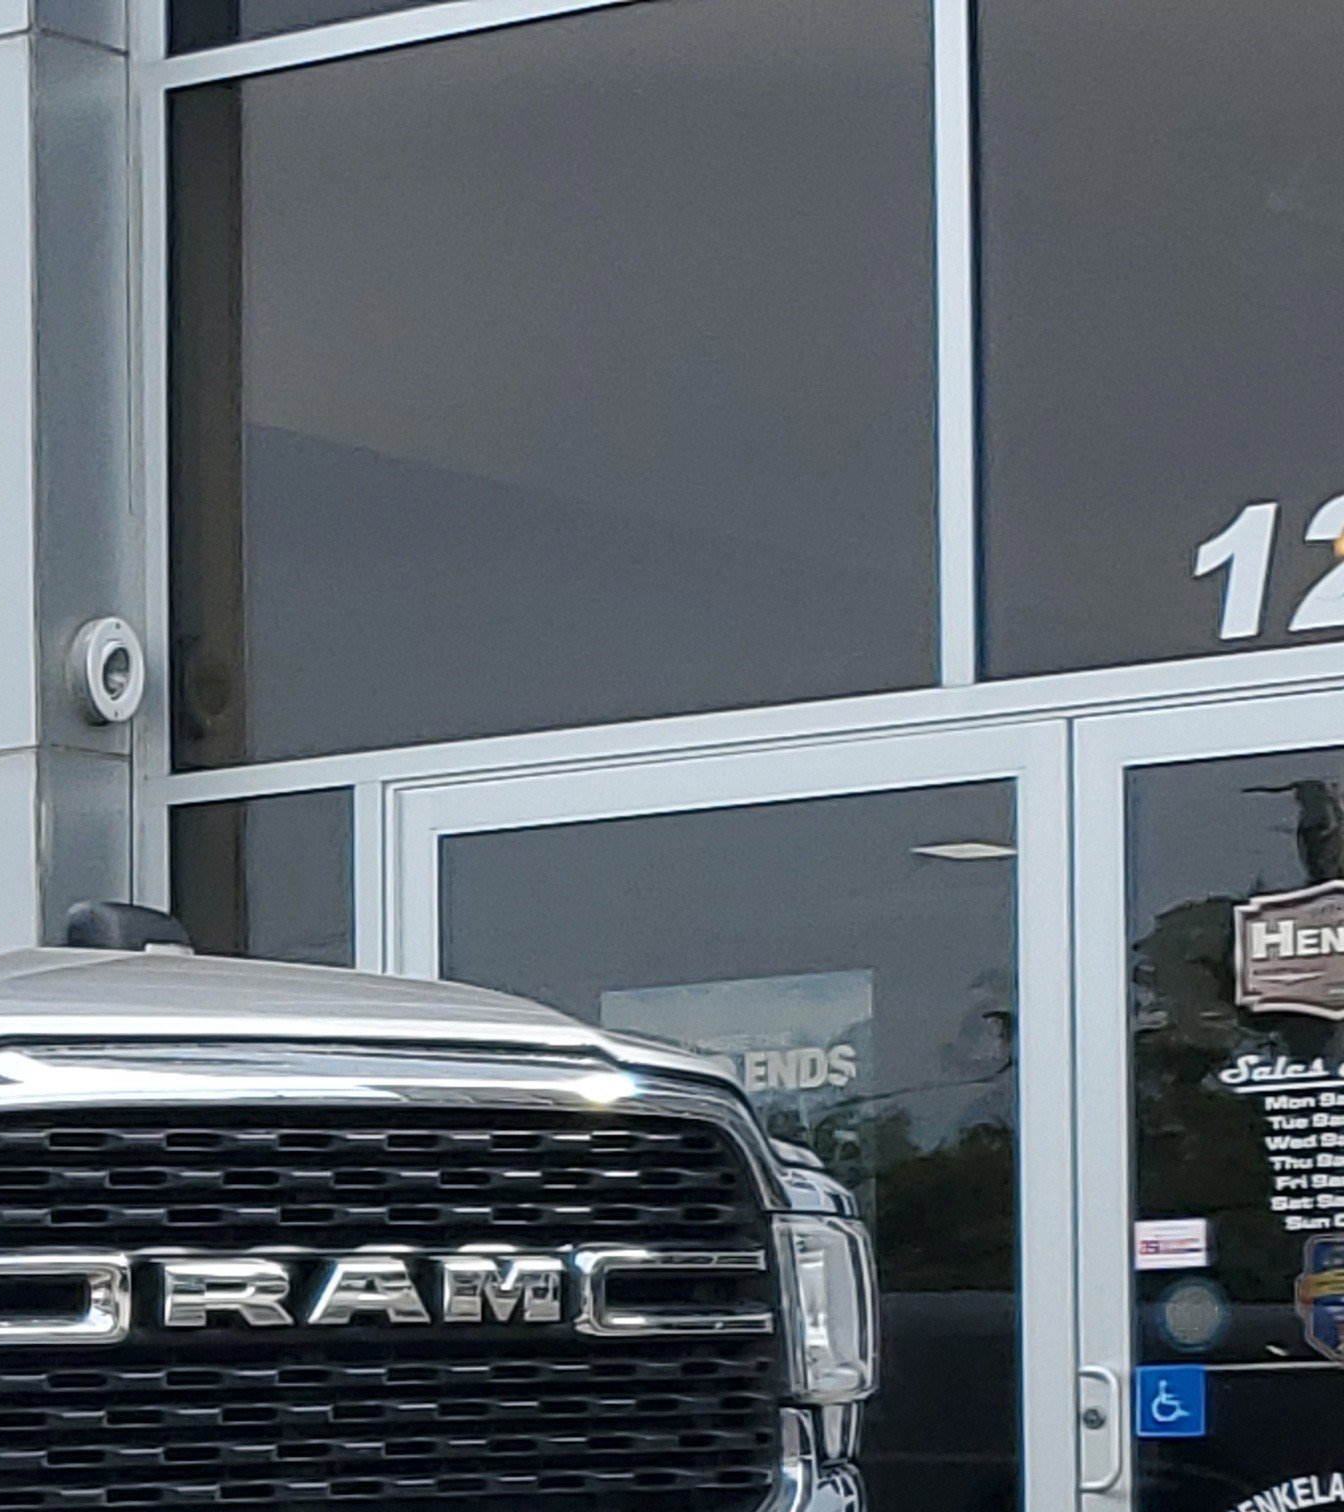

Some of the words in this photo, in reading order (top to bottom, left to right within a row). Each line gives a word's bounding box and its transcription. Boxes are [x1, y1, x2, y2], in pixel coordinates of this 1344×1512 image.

[1265, 1096, 1315, 1111] Mon
[1266, 1116, 1309, 1131] Tue
[1265, 1134, 1317, 1150] Wed
[1268, 1155, 1313, 1171] Thu
[1275, 1174, 1308, 1190] Fri
[1285, 1215, 1330, 1231] Sun
[163, 1257, 564, 1328] RAM
